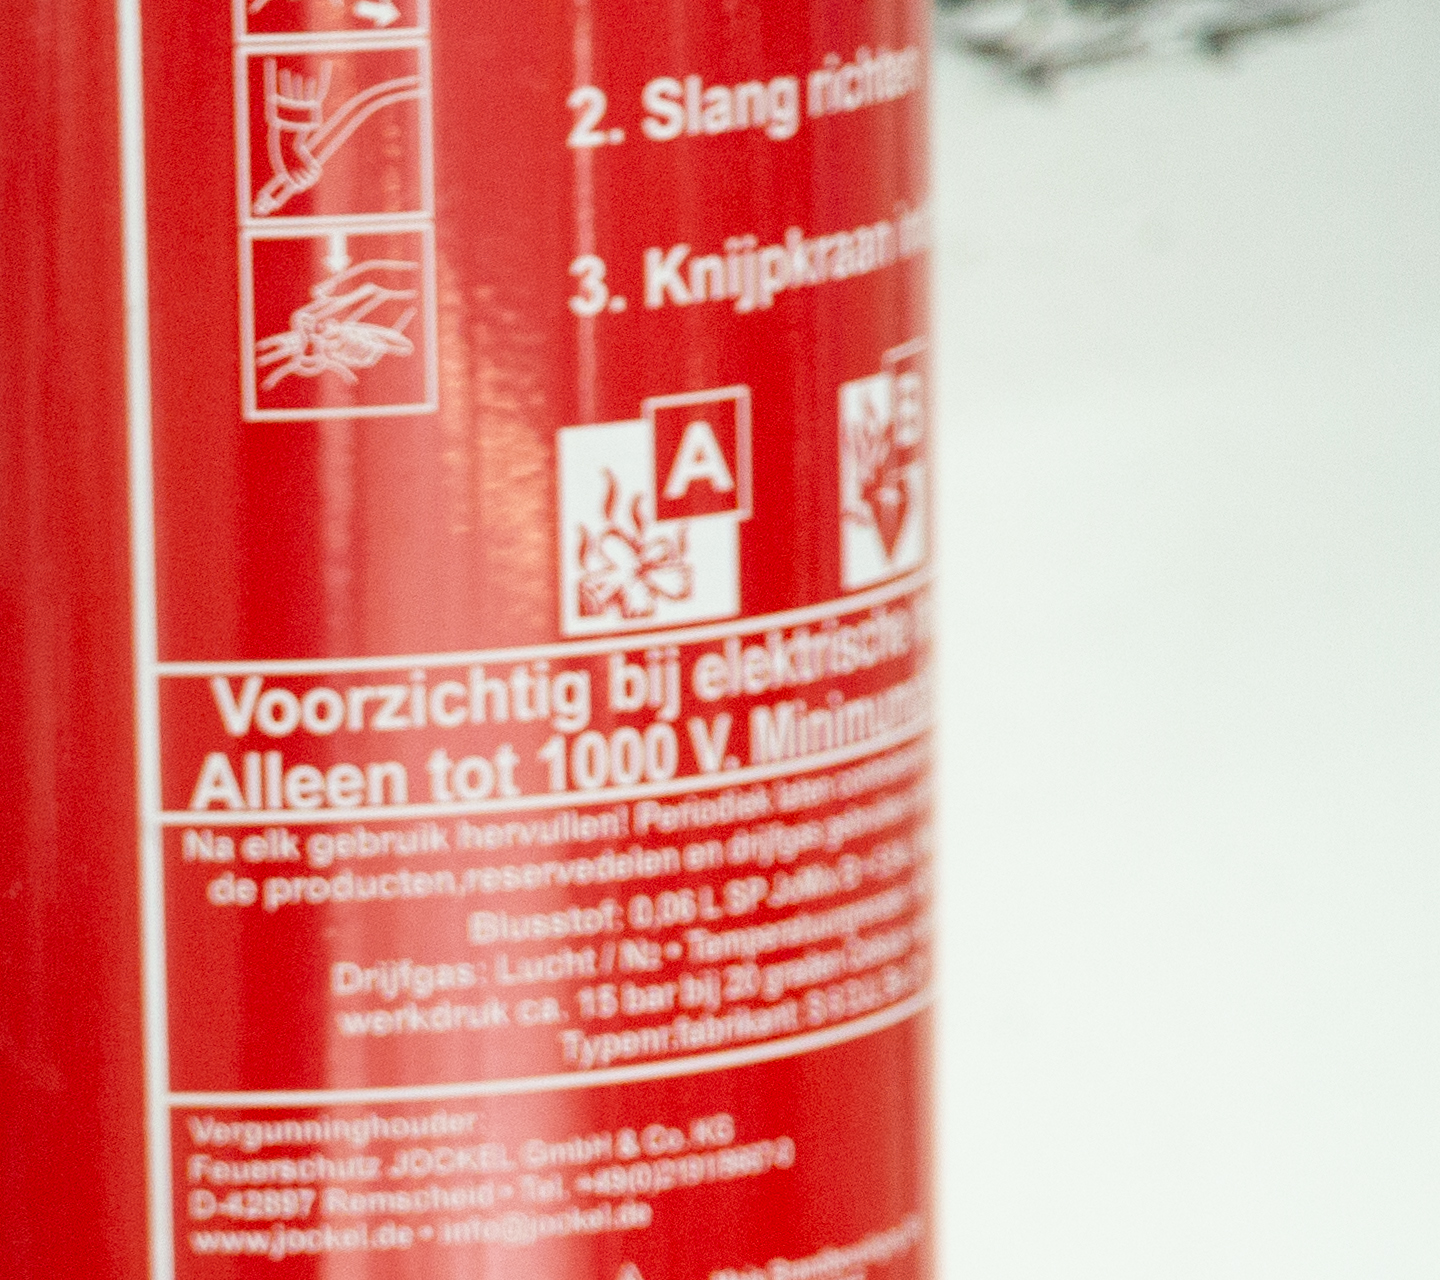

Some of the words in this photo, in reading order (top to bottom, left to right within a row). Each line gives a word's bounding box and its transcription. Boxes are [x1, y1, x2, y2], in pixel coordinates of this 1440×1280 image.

[567, 86, 626, 149] 2.
[642, 75, 800, 141] Slang
[568, 254, 627, 317] 3.
[665, 420, 734, 500] A
[211, 660, 592, 737] Voorzichtig
[609, 649, 681, 722] bij
[188, 749, 410, 811] Alleen
[426, 743, 521, 802] tot
[538, 723, 678, 792] 1000
[688, 713, 741, 775] V.
[306, 821, 450, 868] gebruik
